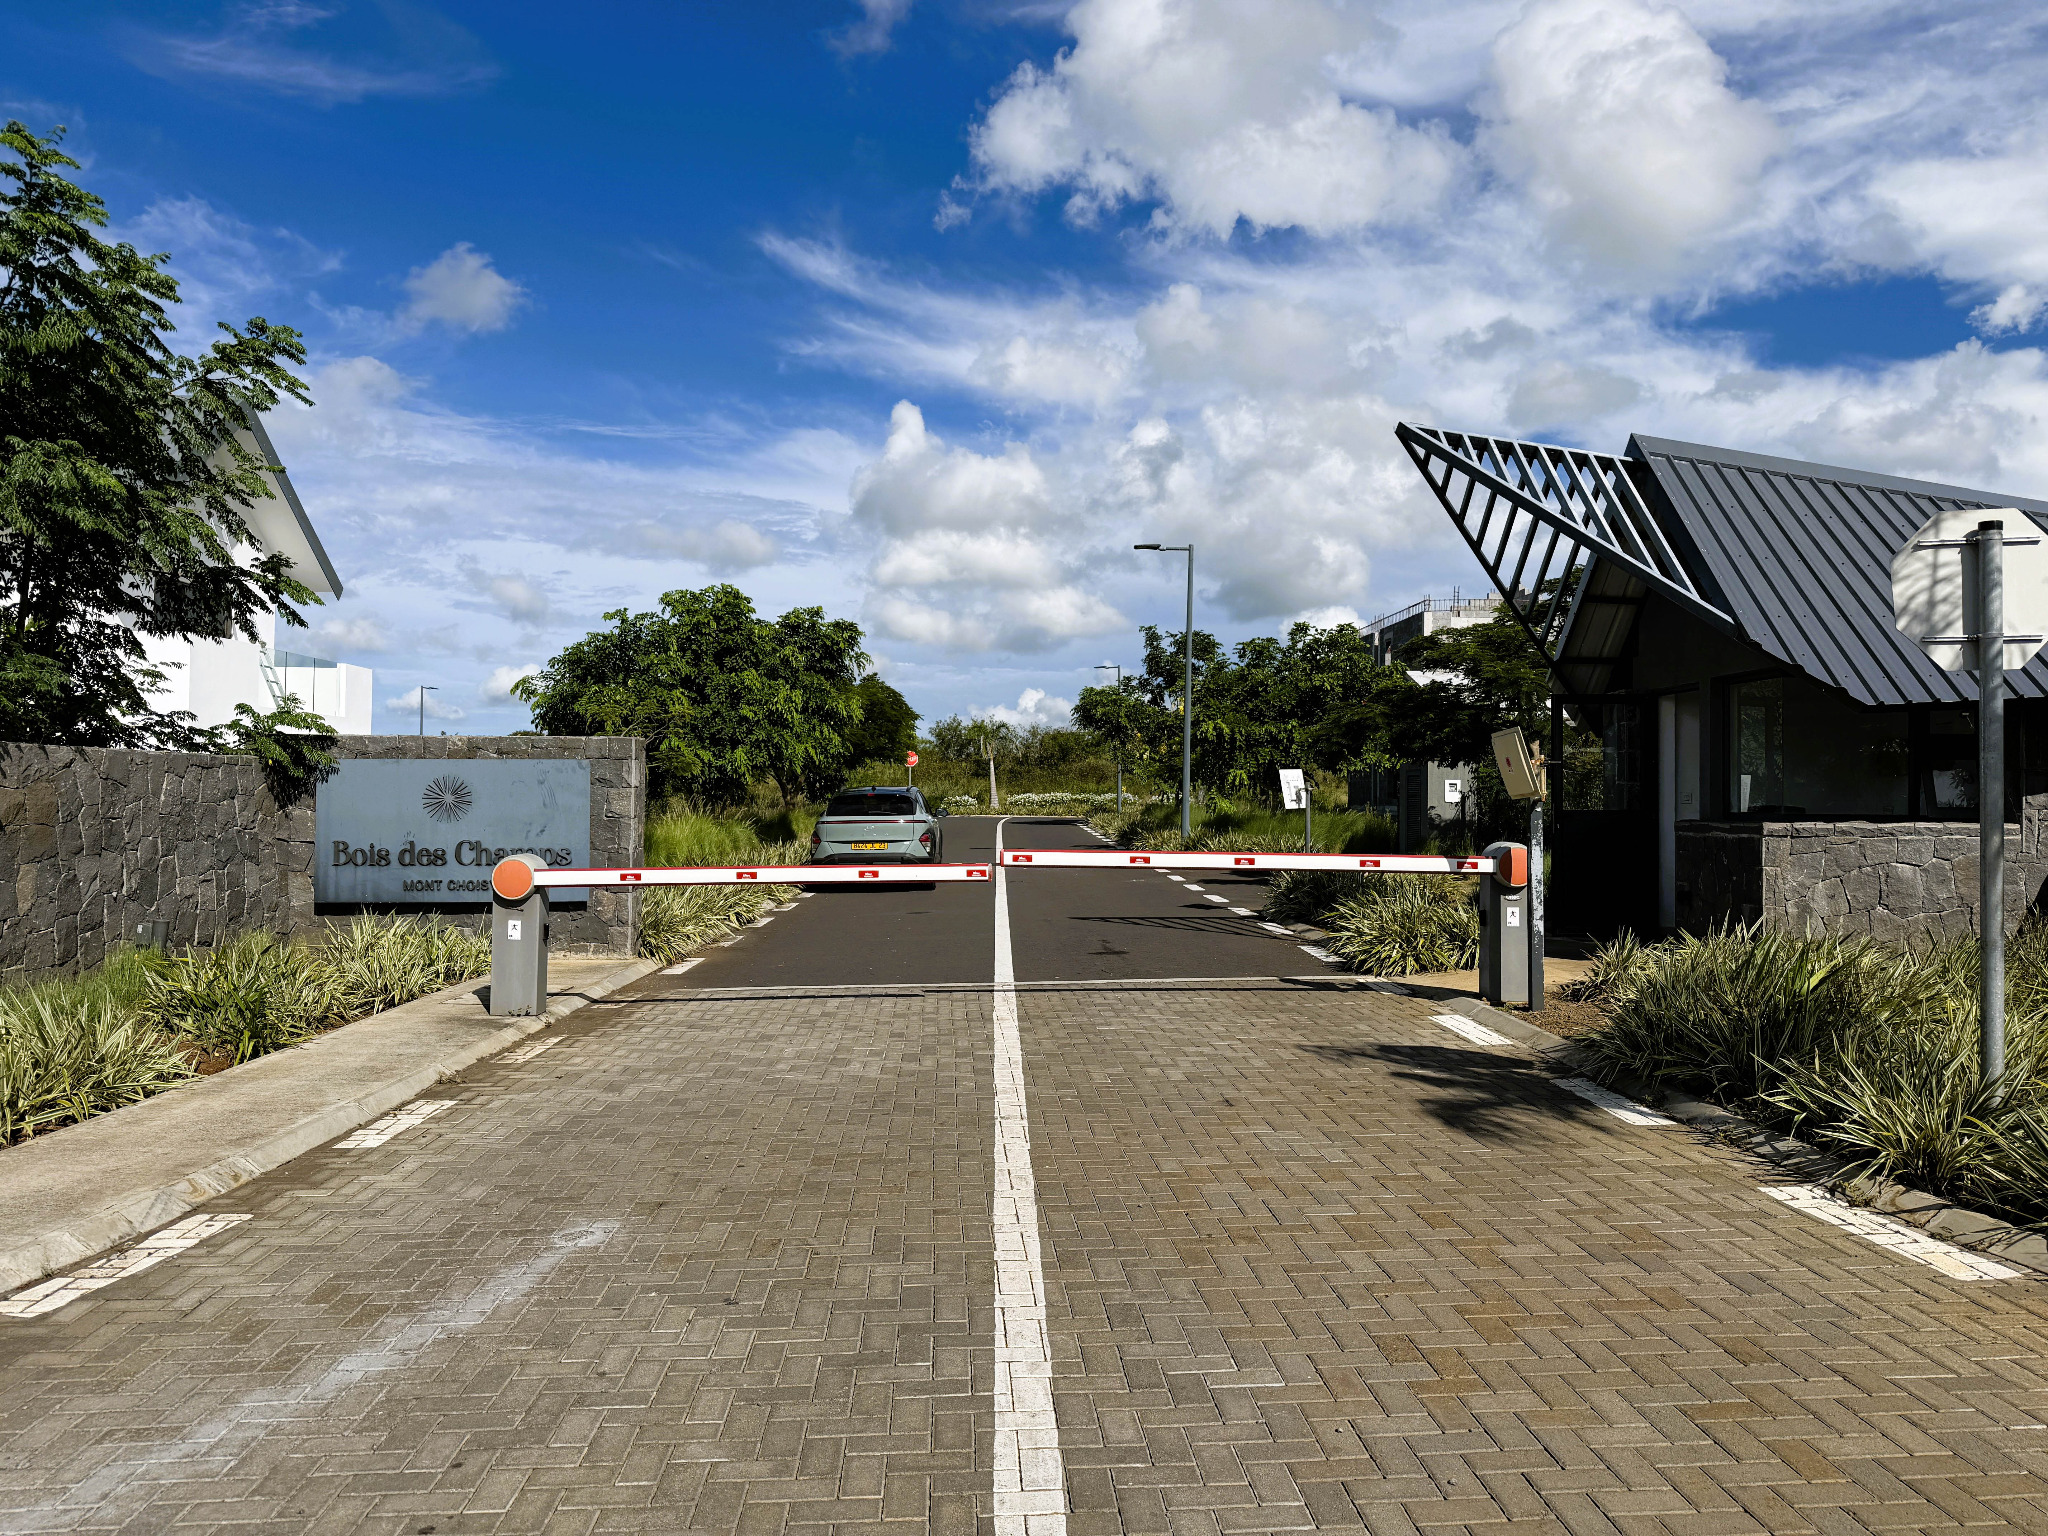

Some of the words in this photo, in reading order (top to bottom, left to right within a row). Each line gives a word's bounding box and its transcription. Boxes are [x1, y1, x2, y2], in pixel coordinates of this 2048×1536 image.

[332, 840, 391, 867] Bois
[397, 840, 447, 867] des
[402, 879, 443, 892] MONT
